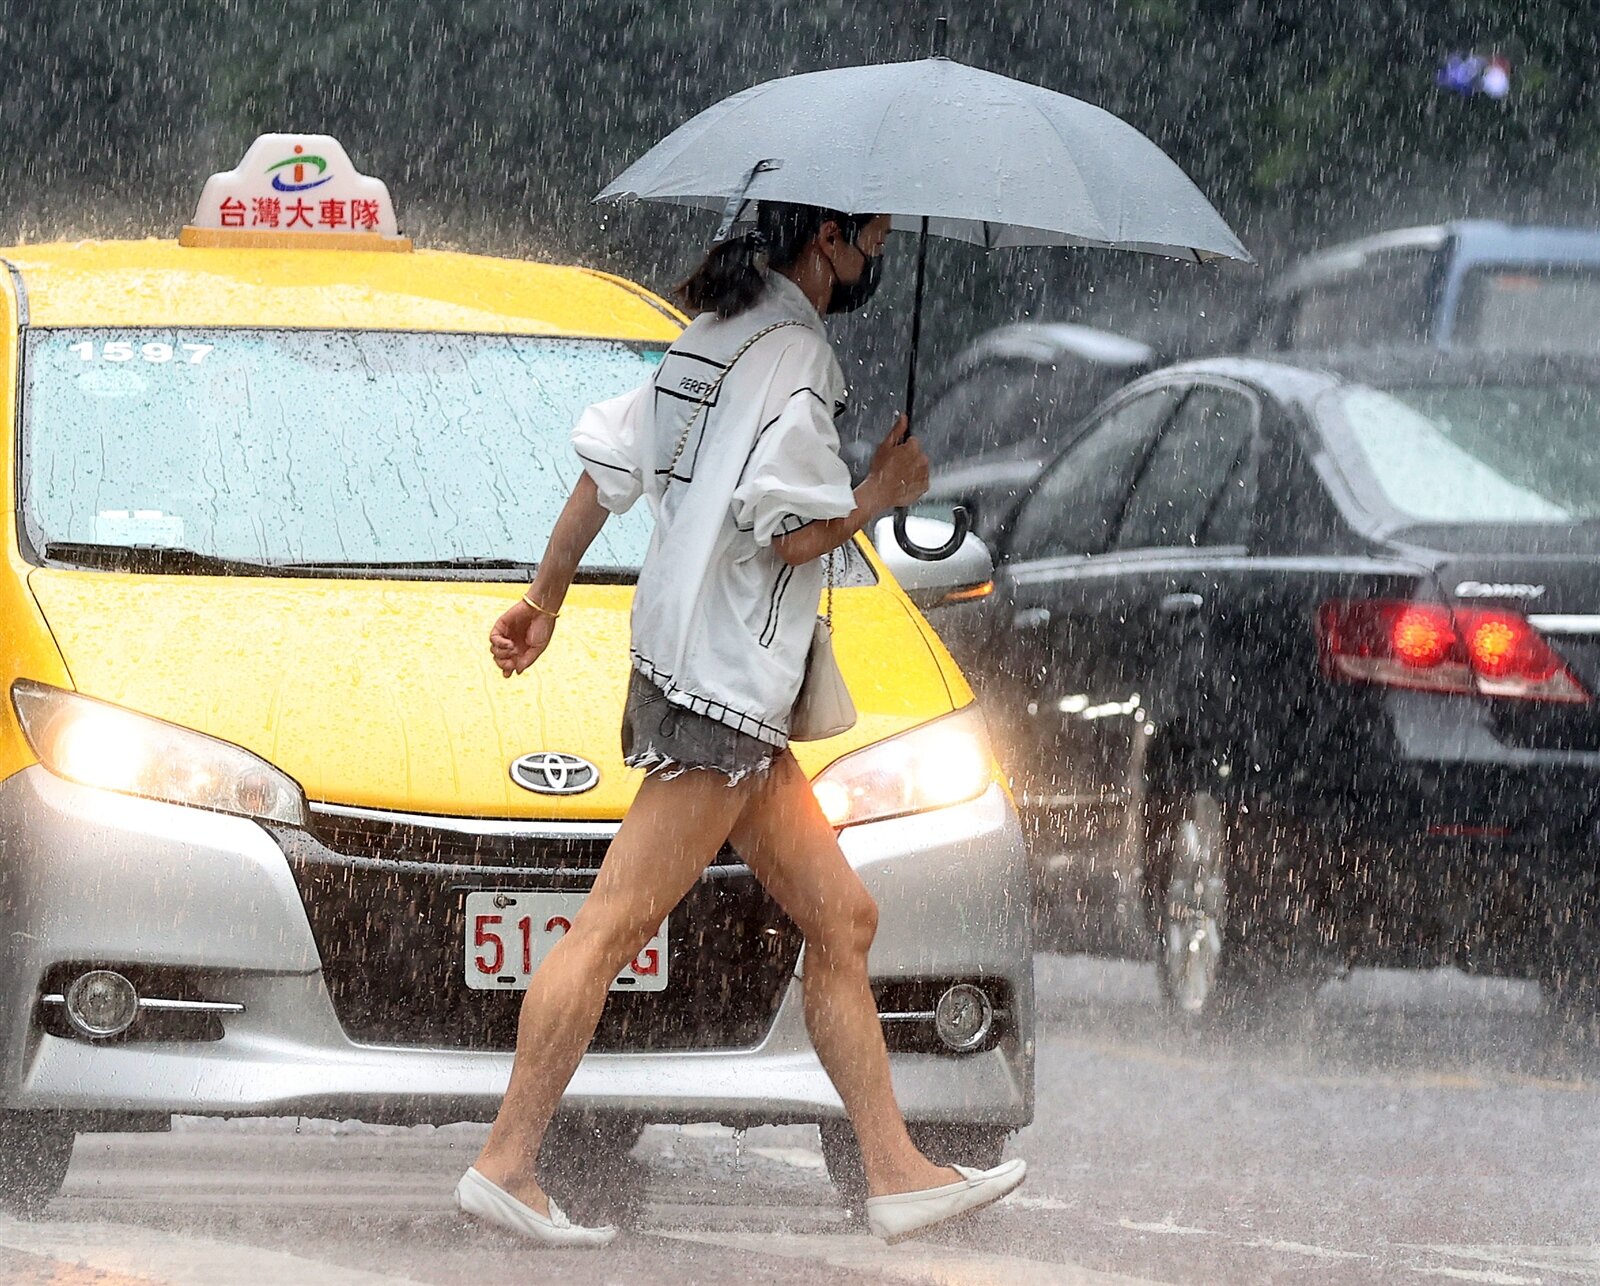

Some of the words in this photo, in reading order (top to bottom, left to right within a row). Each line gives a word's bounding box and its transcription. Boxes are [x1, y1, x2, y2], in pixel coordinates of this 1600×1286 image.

[219, 196, 379, 229] 台灣大車隊
[68, 341, 214, 364] 1597
